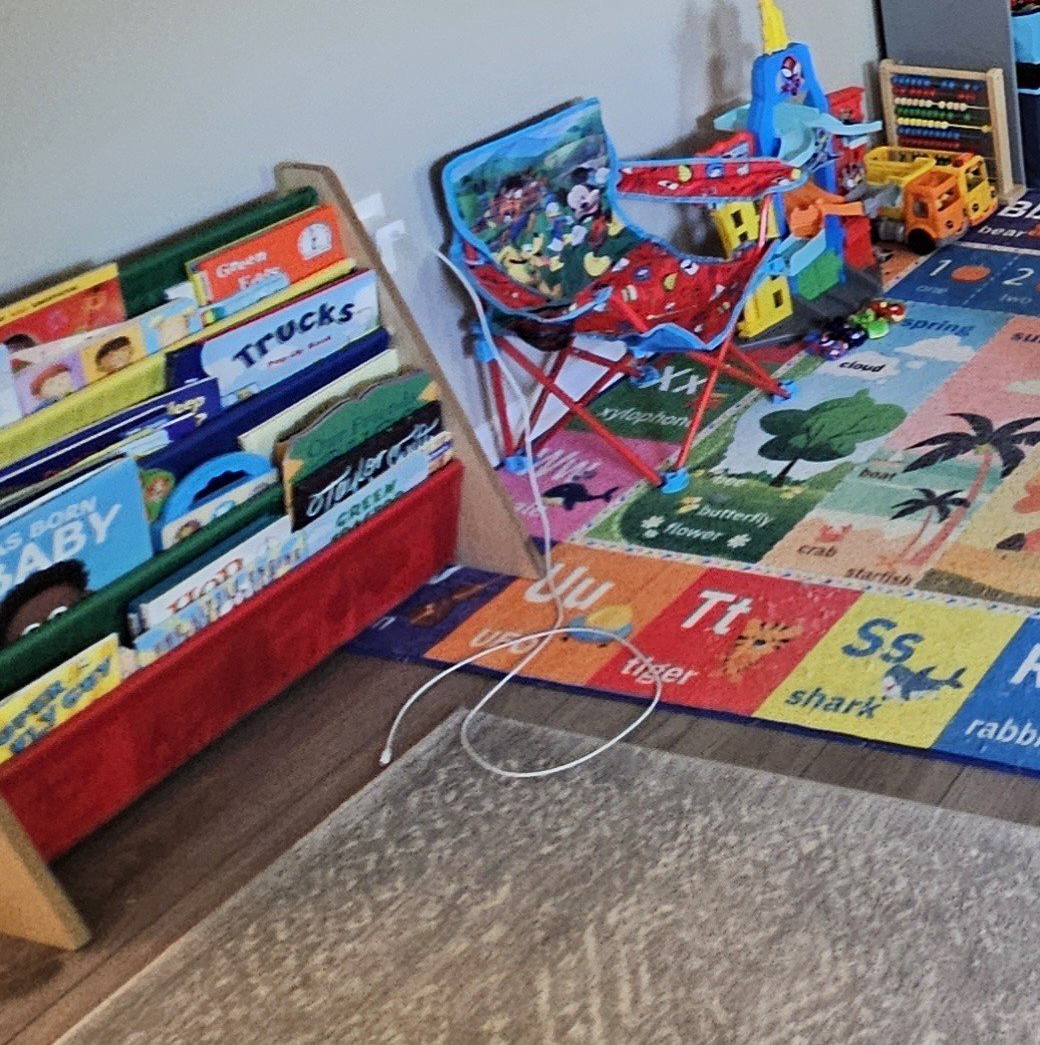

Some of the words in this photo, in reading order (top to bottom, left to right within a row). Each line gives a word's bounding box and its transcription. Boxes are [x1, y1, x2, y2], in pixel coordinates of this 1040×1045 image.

[978, 225, 1028, 239] bear
[929, 259, 951, 277] 1
[1003, 267, 1035, 286] 2
[1000, 293, 1033, 304] two
[901, 318, 974, 336] spring
[839, 359, 886, 375] cloud
[638, 365, 708, 395] Xx
[859, 467, 897, 482] boat
[697, 504, 774, 528] butterfly
[663, 521, 726, 542] flower
[797, 544, 839, 558] crab
[843, 567, 914, 586] starfish
[681, 588, 753, 636] Tt
[841, 617, 925, 665] Ss
[620, 656, 700, 685] tiger
[784, 686, 884, 720] shark
